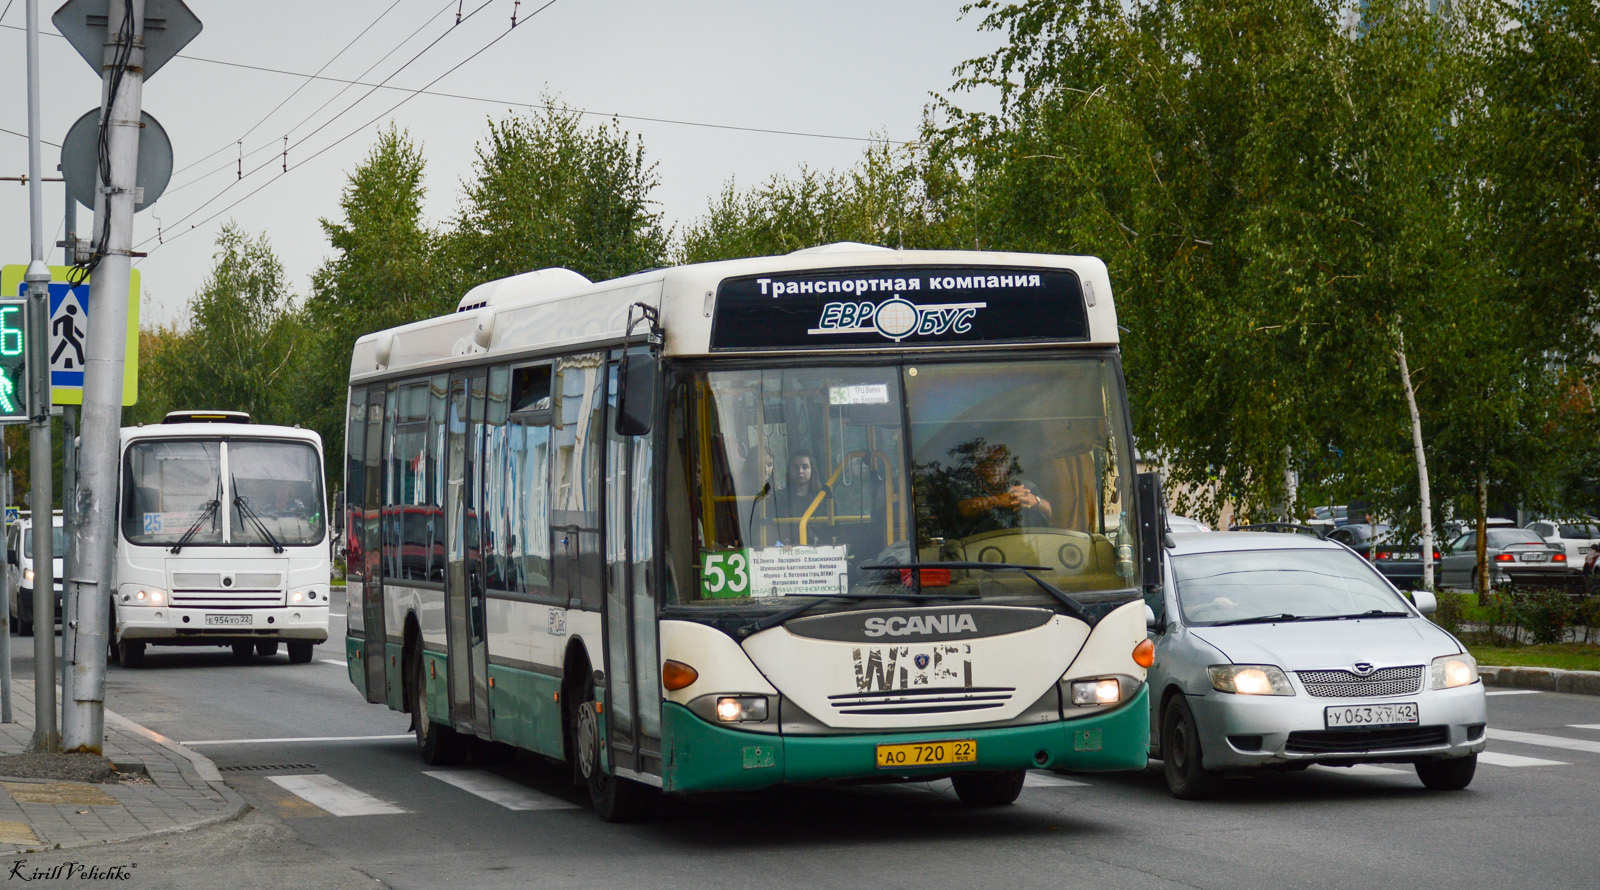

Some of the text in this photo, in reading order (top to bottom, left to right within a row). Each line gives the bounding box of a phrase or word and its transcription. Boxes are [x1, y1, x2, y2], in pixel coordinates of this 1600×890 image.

[757, 275, 1041, 298] Транспортная компания
[0, 307, 22, 355] 6
[830, 387, 850, 404] 53
[144, 514, 162, 532] 25
[704, 553, 748, 592] 53
[864, 613, 978, 637] SCANIA
[1397, 706, 1412, 718] 42
[885, 743, 971, 764] АО 720 22
